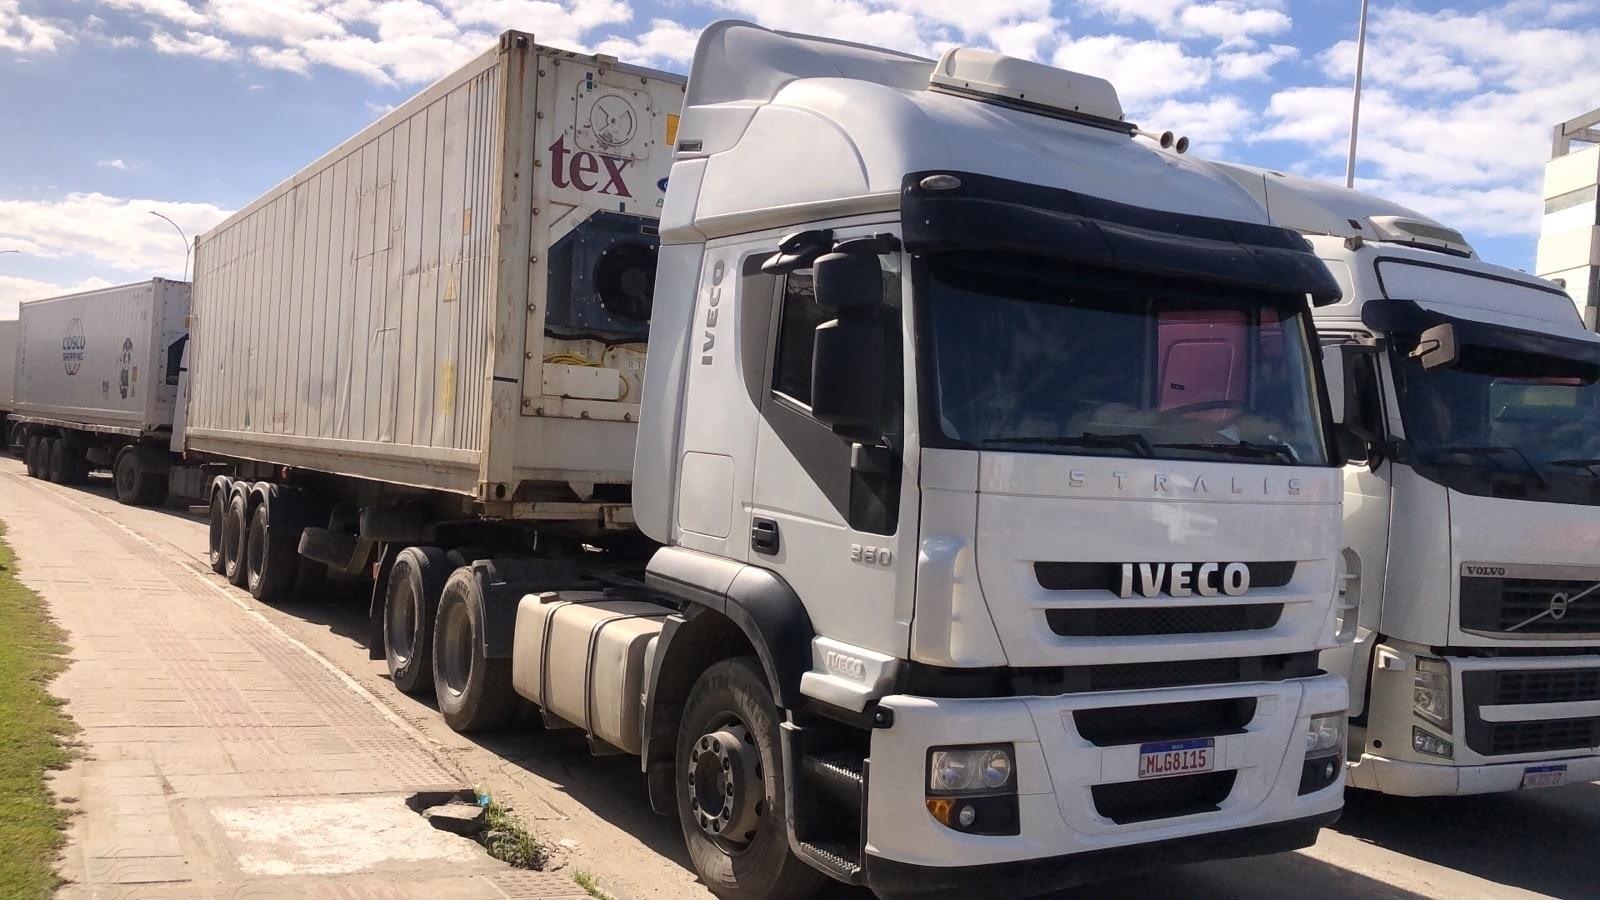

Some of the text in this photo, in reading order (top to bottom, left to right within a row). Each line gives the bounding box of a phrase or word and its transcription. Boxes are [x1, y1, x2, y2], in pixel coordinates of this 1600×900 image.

[548, 134, 633, 198] tex
[701, 259, 725, 365] IVECO
[1068, 468, 1302, 496] STRALIS
[1120, 562, 1251, 598] IVECO
[1467, 566, 1505, 577] VOLVO
[826, 651, 865, 676] IVECO
